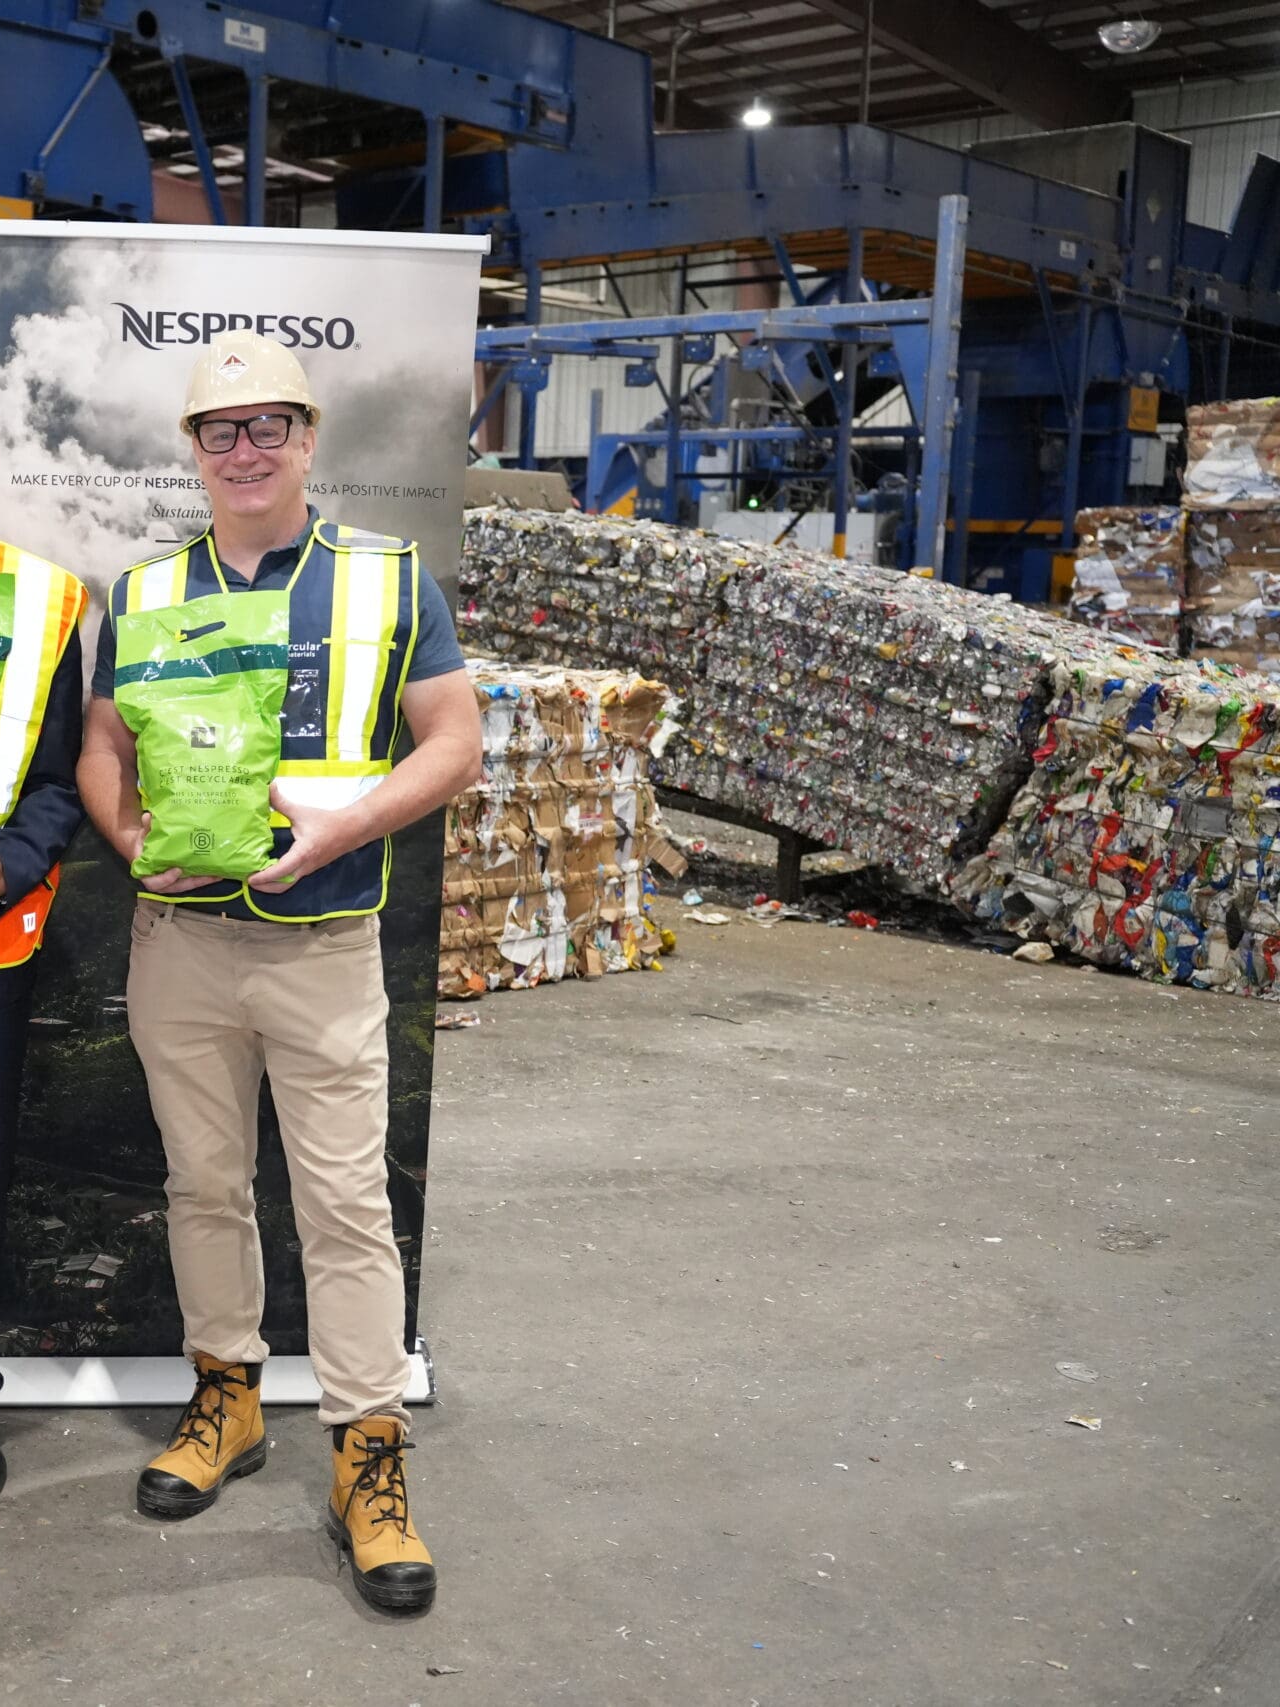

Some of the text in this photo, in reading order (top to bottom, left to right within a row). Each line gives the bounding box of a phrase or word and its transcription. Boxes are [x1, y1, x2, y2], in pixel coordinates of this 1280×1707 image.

[11, 474, 49, 485] MAKE
[51, 475, 92, 487] EVERY
[94, 475, 121, 488] CUP
[124, 476, 141, 488] OF
[303, 483, 327, 495] HAS
[330, 484, 339, 495] A
[342, 484, 400, 498] POSITIVE
[403, 487, 448, 499] IMPACT
[152, 504, 213, 519] Sustaina
[189, 765, 250, 775] NESPRESSO
[186, 775, 251, 786] RECYCLABLE
